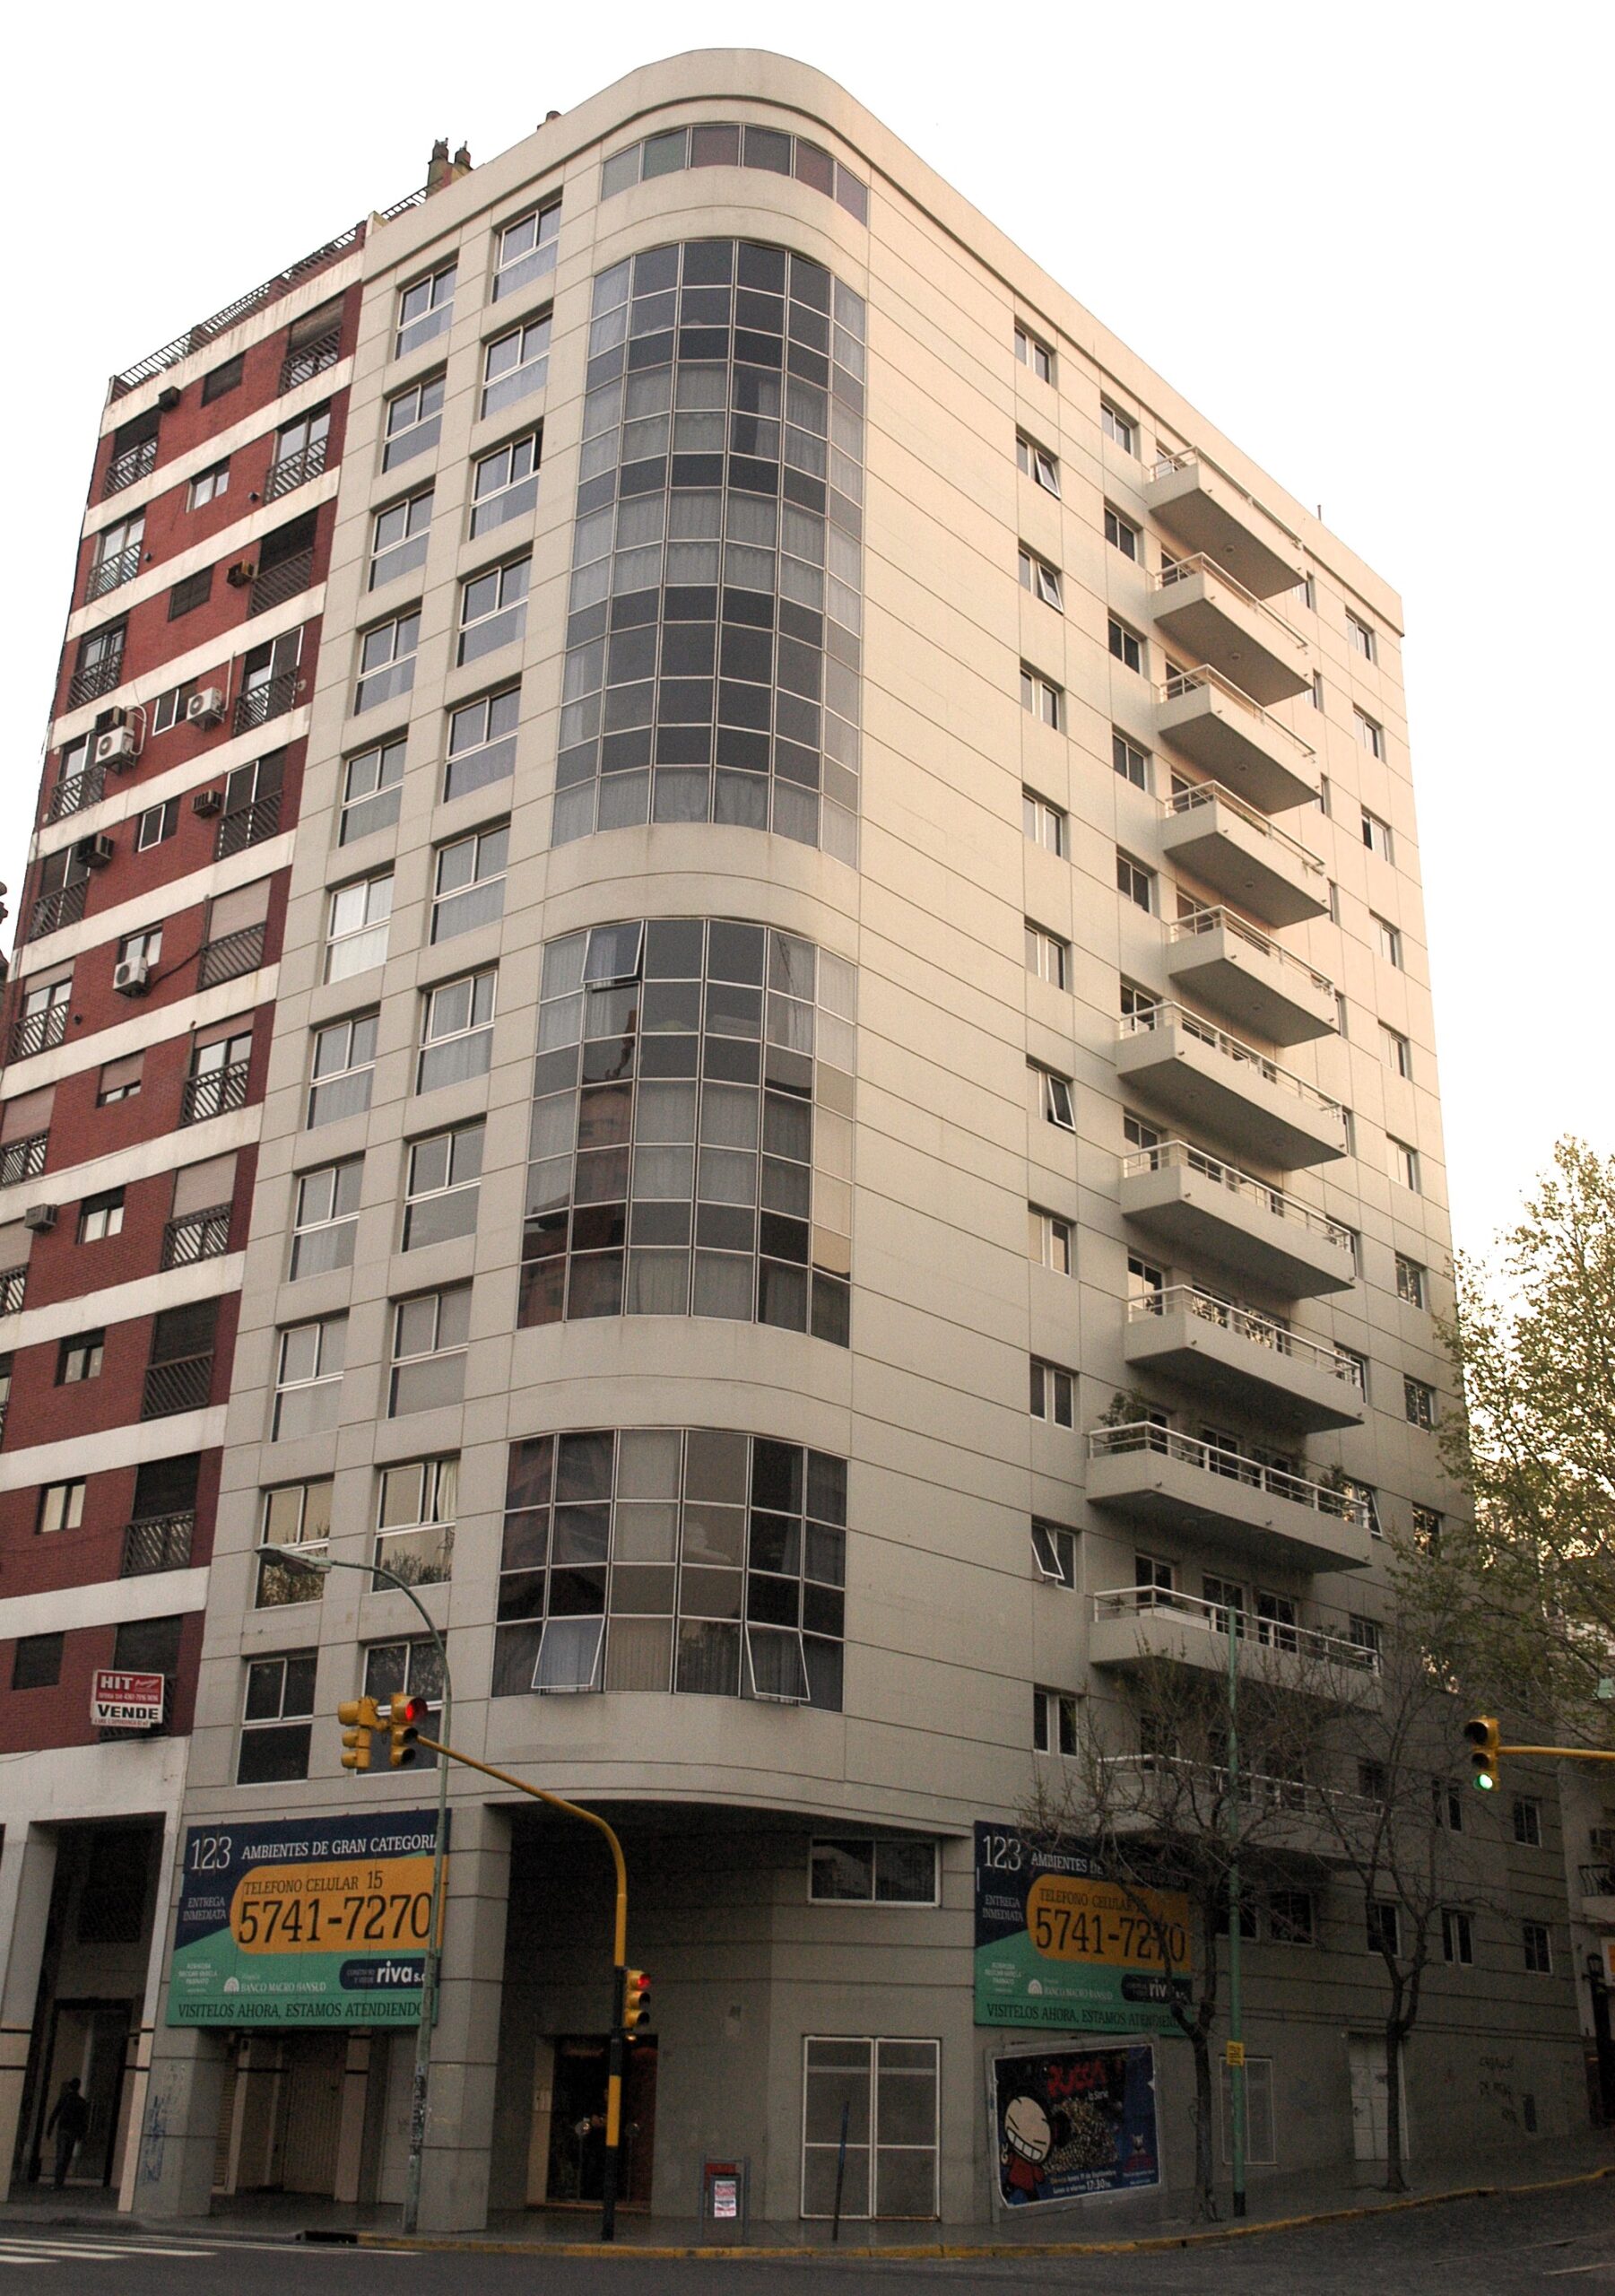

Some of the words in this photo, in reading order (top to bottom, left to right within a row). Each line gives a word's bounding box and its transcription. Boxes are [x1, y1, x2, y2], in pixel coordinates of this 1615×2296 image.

[100, 1675, 134, 1691] HIT
[98, 1705, 159, 1719] VENDE
[190, 1837, 232, 1871] 123
[241, 1839, 308, 1860] AMBIENTES
[312, 1839, 329, 1856] DE
[332, 1837, 367, 1855] GRAN
[983, 1835, 1021, 1871] 123
[1031, 1851, 1088, 1872] AMBIENTES
[244, 1880, 302, 1896] TELEFONO
[306, 1876, 359, 1892] CELULAR
[367, 1871, 384, 1890] 15
[187, 1896, 226, 1908] ENTREGA
[985, 1893, 1021, 1908] ENTREGA
[1039, 1888, 1089, 1906] TELEFONO
[182, 1909, 227, 1922] INMEDIATA
[238, 1892, 433, 1944] 5741-7270
[982, 1909, 1024, 1923] INMEDIATA
[377, 1961, 412, 1984] riva
[1150, 1979, 1168, 1999] riv
[178, 2004, 234, 2018] VISITELOS
[237, 2003, 282, 2019] AHORA,
[285, 2003, 342, 2017] ESTAMOS
[987, 2003, 1039, 2020] VISITELOS
[1081, 2009, 1127, 2025] ESTAMOS
